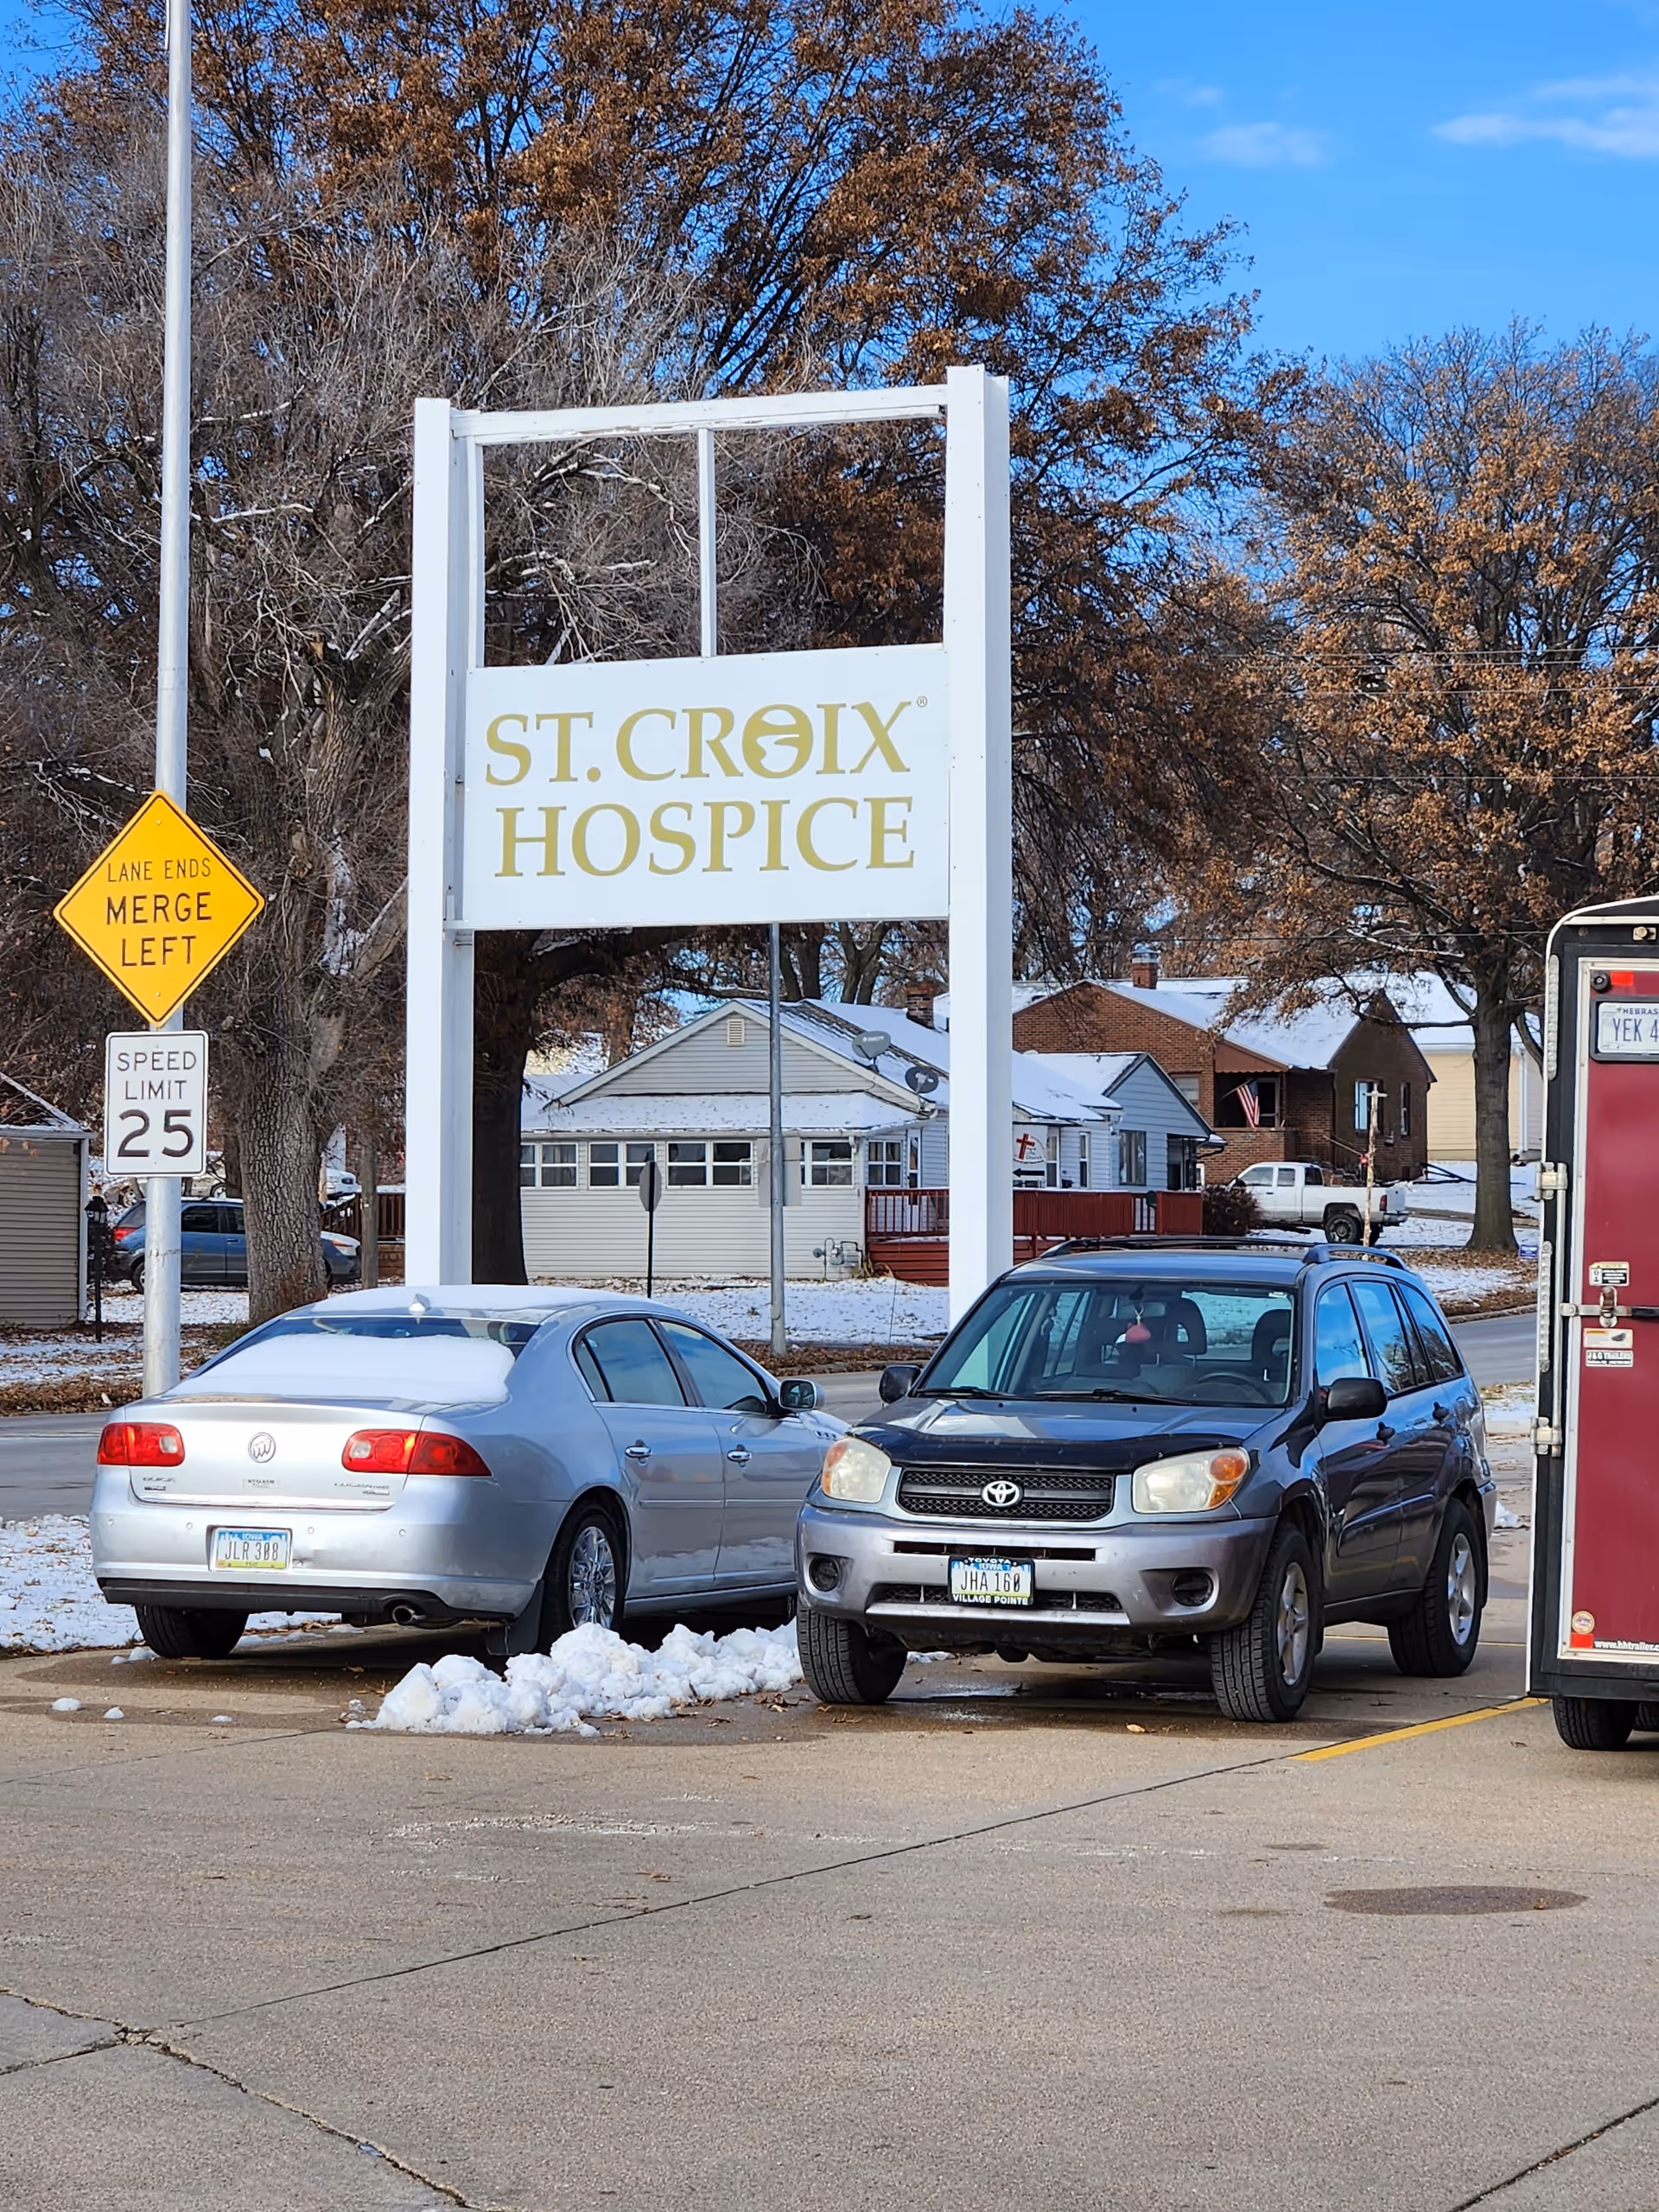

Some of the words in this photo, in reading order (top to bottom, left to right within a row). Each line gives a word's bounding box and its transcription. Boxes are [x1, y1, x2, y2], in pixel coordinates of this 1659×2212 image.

[486, 712, 601, 785] ST.
[494, 797, 915, 877] HOSPICE
[108, 861, 153, 882] LANE
[164, 857, 211, 880] ENDS
[107, 892, 212, 925] MERGE
[122, 935, 197, 967] LEFT
[1612, 1018, 1643, 1042] YEK
[117, 1051, 197, 1071] SPEED
[124, 1080, 188, 1100] LIMIT
[117, 1109, 194, 1158] 25
[242, 1532, 264, 1541] IOWA
[225, 1541, 250, 1560] JLR
[255, 1541, 279, 1561] 308
[961, 1571, 988, 1591] JHA
[995, 1573, 1020, 1592] 160
[952, 1593, 992, 1604] VILLAGE
[994, 1596, 1029, 1605] POINTE
